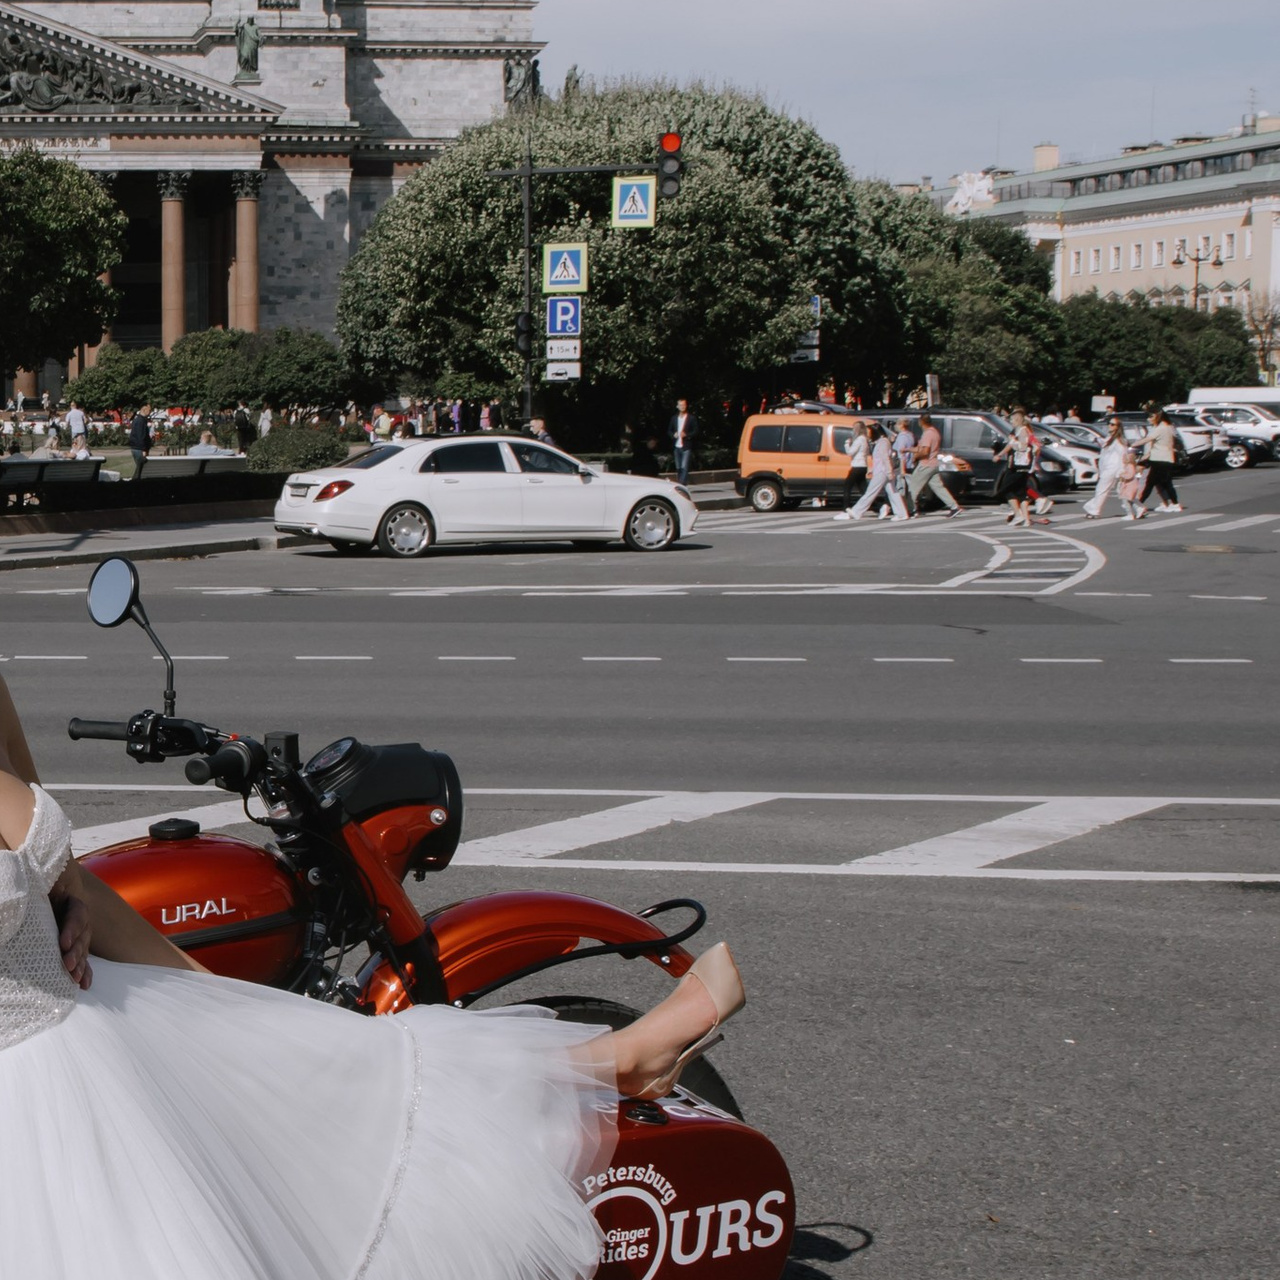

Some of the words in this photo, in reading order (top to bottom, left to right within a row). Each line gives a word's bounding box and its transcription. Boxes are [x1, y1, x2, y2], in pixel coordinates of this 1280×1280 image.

[556, 301, 575, 331] P
[161, 897, 237, 925] URAL
[582, 1163, 677, 1206] Petersburg
[606, 1227, 651, 1243] Ginger
